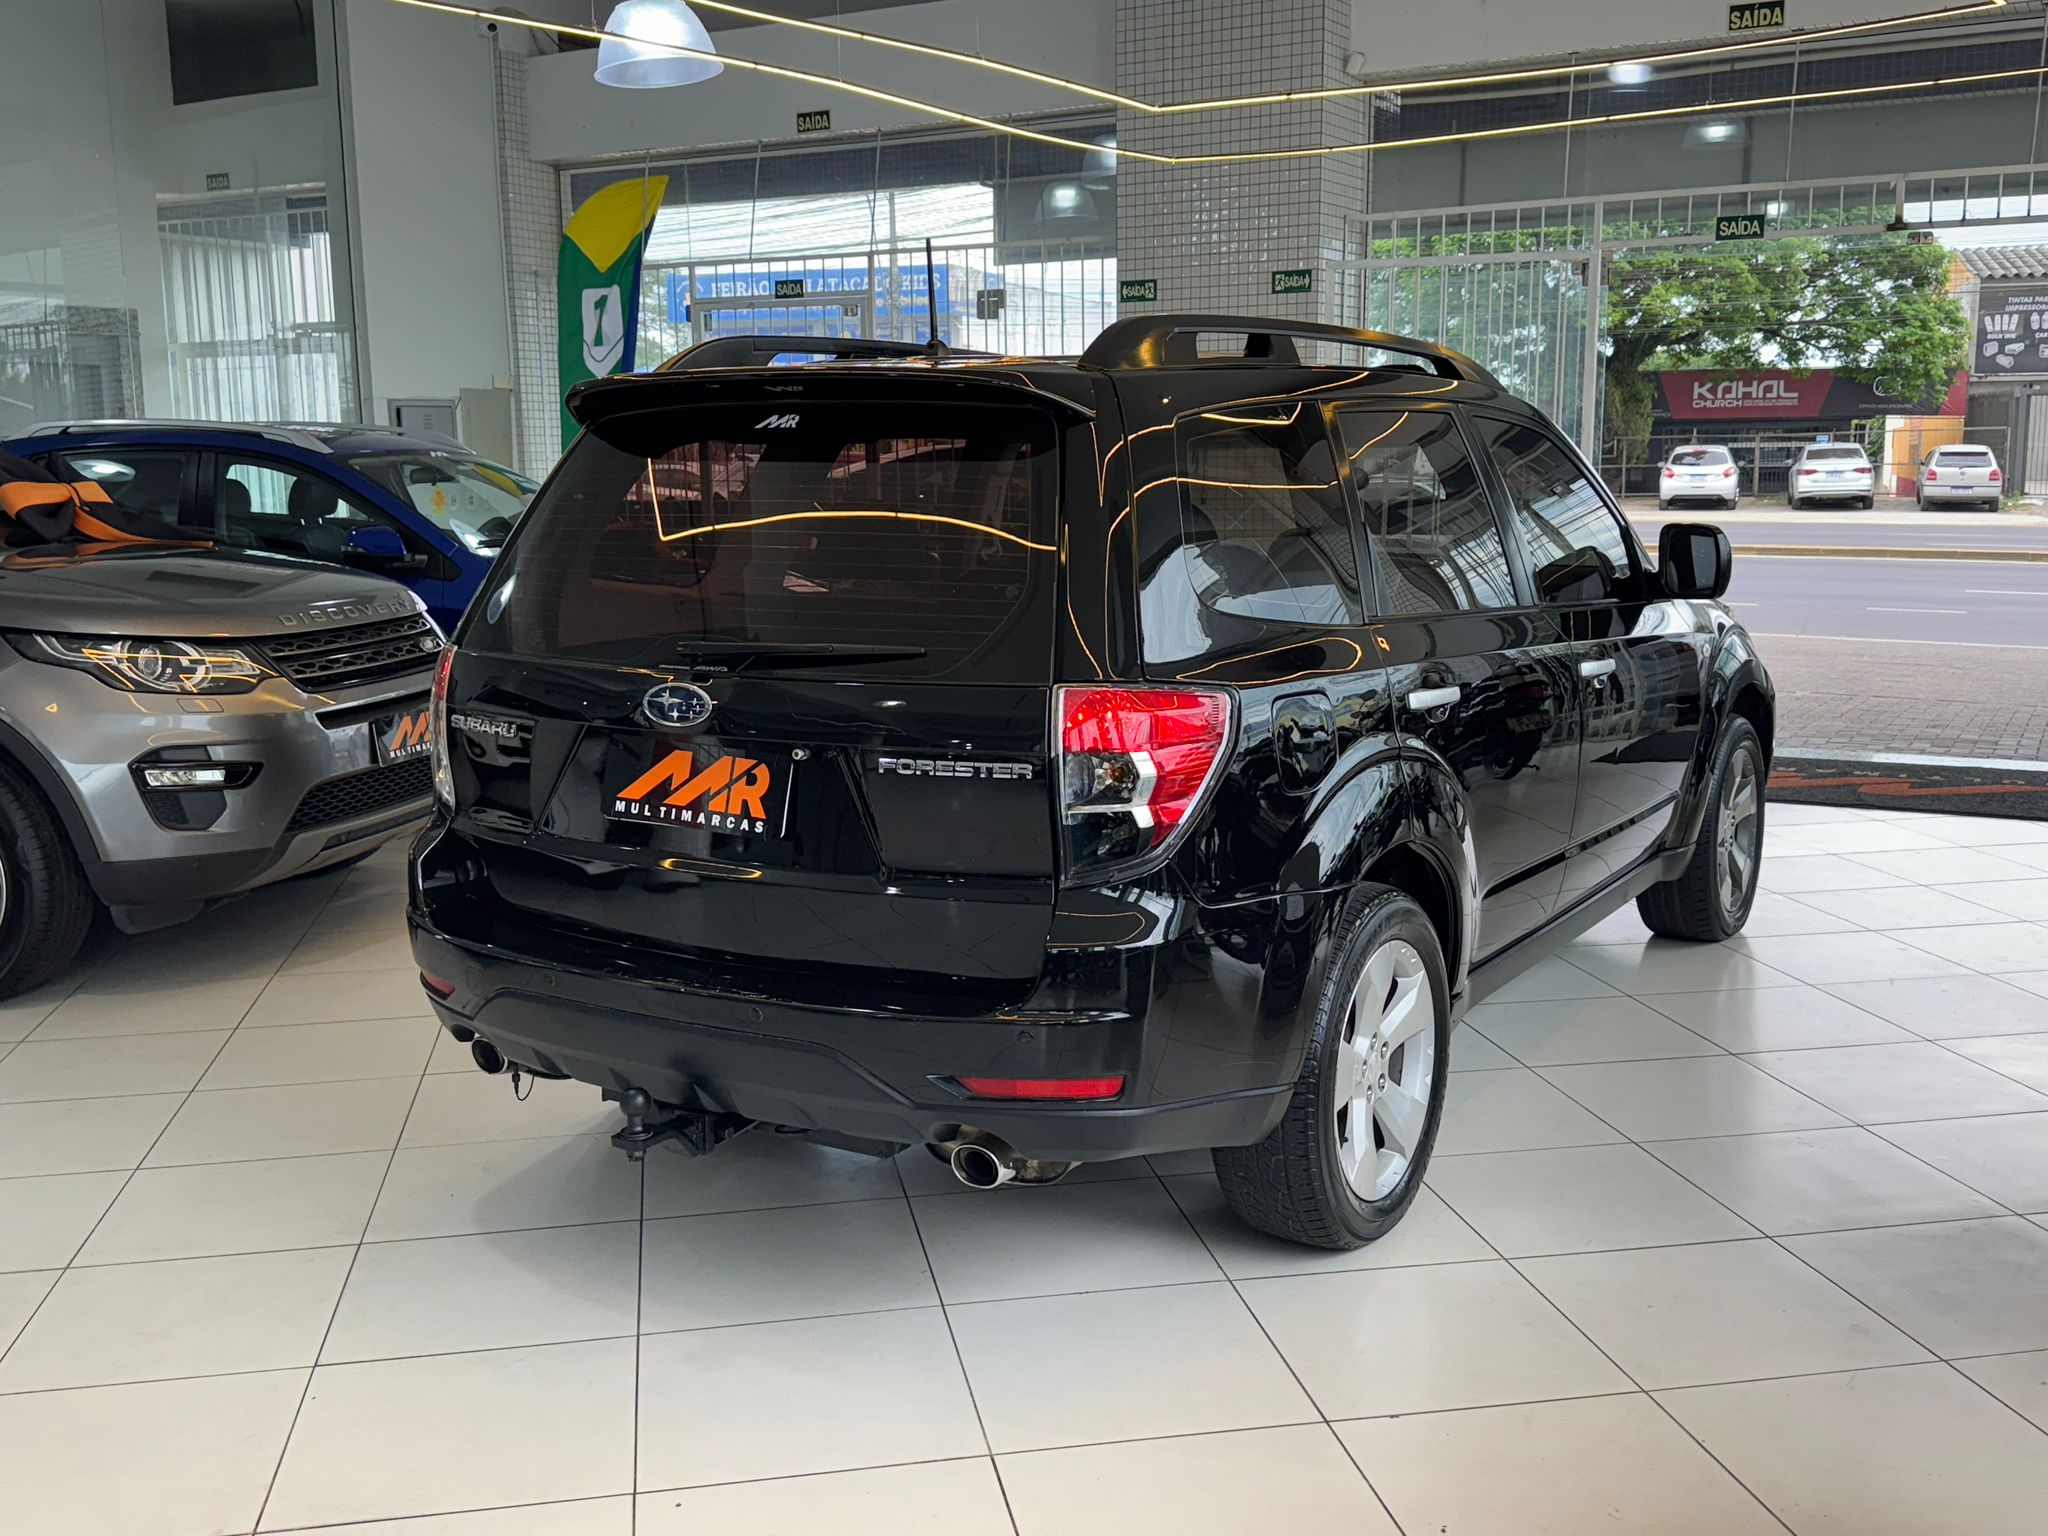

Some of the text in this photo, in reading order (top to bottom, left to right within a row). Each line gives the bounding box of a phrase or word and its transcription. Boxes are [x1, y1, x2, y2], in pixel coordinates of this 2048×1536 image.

[1730, 4, 1783, 29] SAÍDA
[798, 112, 829, 131] SAÍDA
[1719, 217, 1761, 236] SAÍDA
[776, 280, 802, 296] SAÍDA
[1127, 283, 1146, 297] SAÍDA
[1284, 273, 1304, 288] SAÍDA
[1692, 379, 1799, 400] KAHAL
[1692, 399, 1743, 408] CHURCH
[279, 600, 411, 626] DISCOVERY
[451, 714, 518, 737] SUBARU
[878, 757, 1034, 780] FORESTER
[614, 799, 765, 834] MULTIMARCAS
